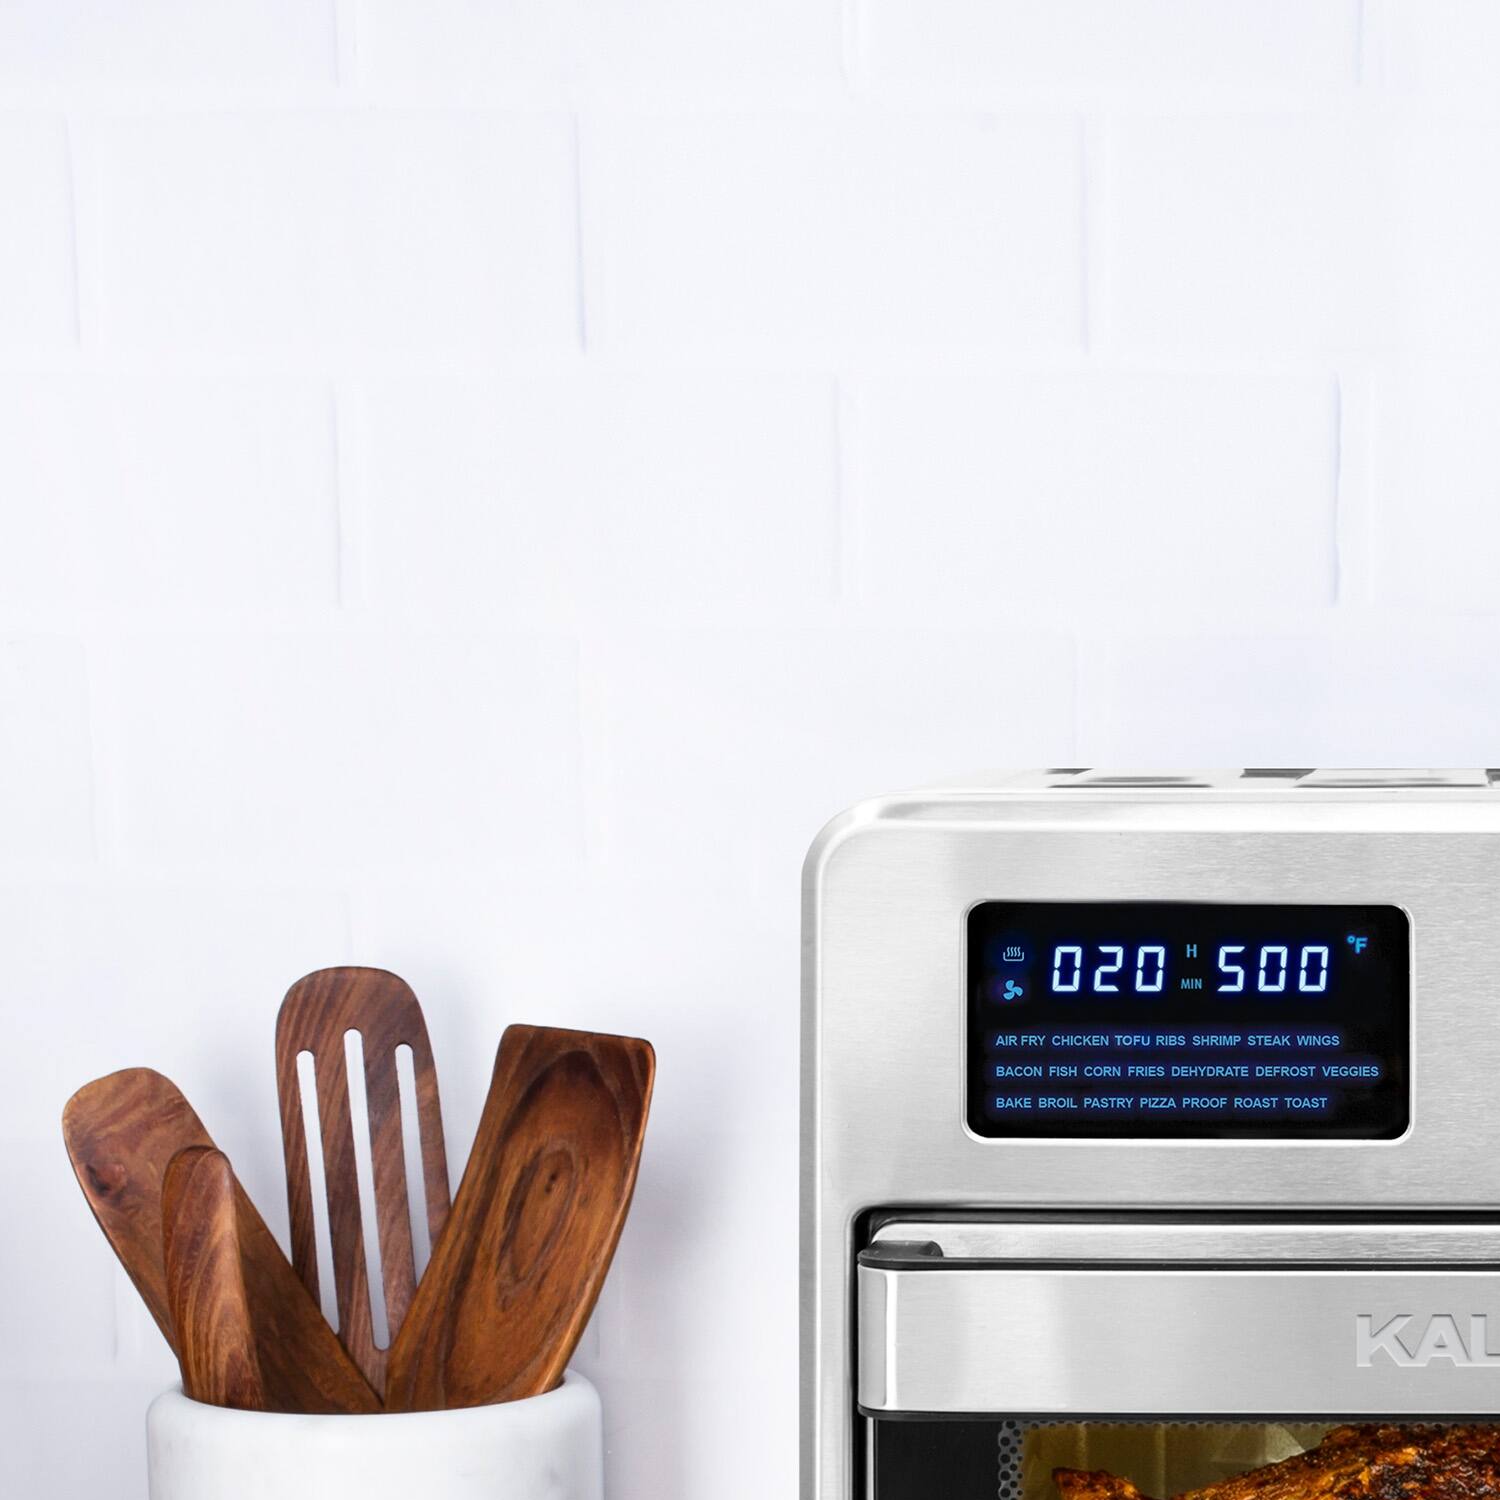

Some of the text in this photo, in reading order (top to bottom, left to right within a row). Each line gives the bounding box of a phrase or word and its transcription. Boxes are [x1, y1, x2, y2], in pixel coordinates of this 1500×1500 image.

[1186, 944, 1197, 958] H
[1051, 945, 1166, 992] 020
[1217, 945, 1330, 992] 500
[1180, 978, 1202, 990] MIN
[995, 1034, 1340, 1046] AIR FRY CHICKEN TOFU RIBS SHRIMP STEAK WINGS
[995, 1065, 1379, 1077] BACON FISH CORN FRIES DEHYDRATE DEFROST VEGGIES
[995, 1097, 1327, 1109] BAKE BROIL PASTRY PIZZA PROOF ROAST TOAST
